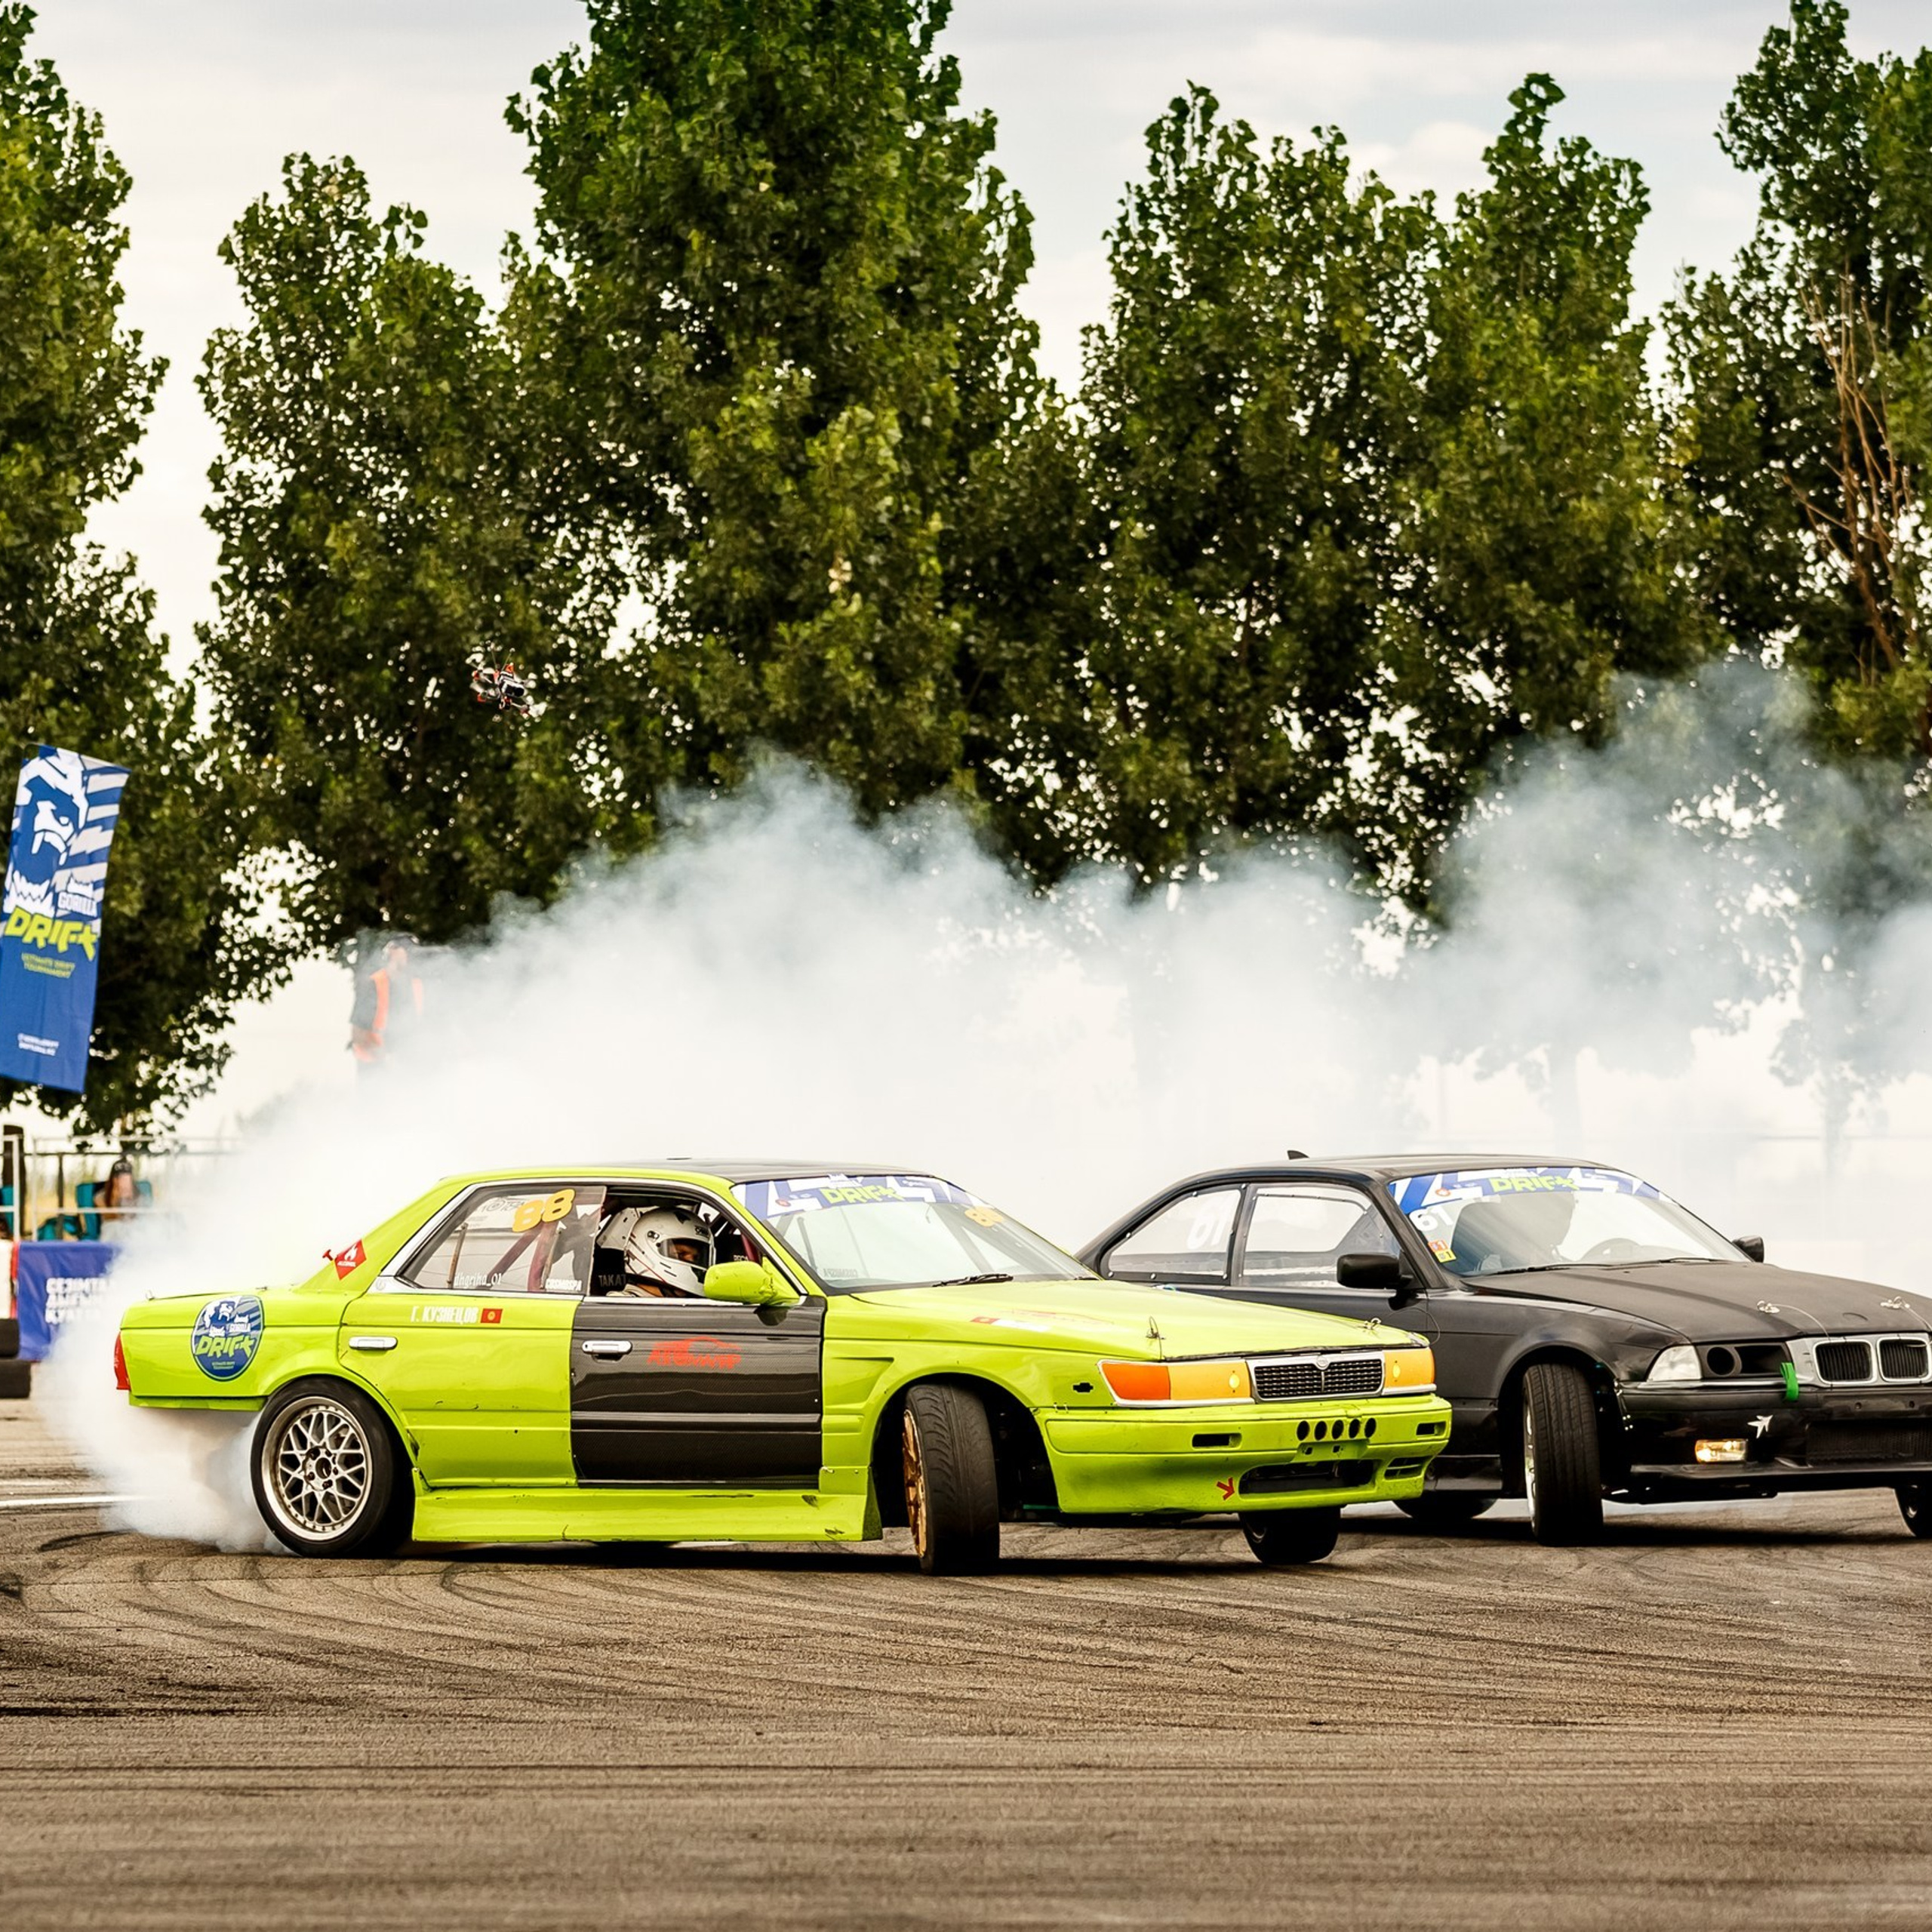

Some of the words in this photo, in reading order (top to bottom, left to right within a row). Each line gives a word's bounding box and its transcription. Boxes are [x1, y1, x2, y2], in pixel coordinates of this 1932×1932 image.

[512, 1189, 576, 1232] 88
[1409, 1206, 1454, 1232] 61
[422, 1306, 479, 1325] КУЗНЕЦОВ
